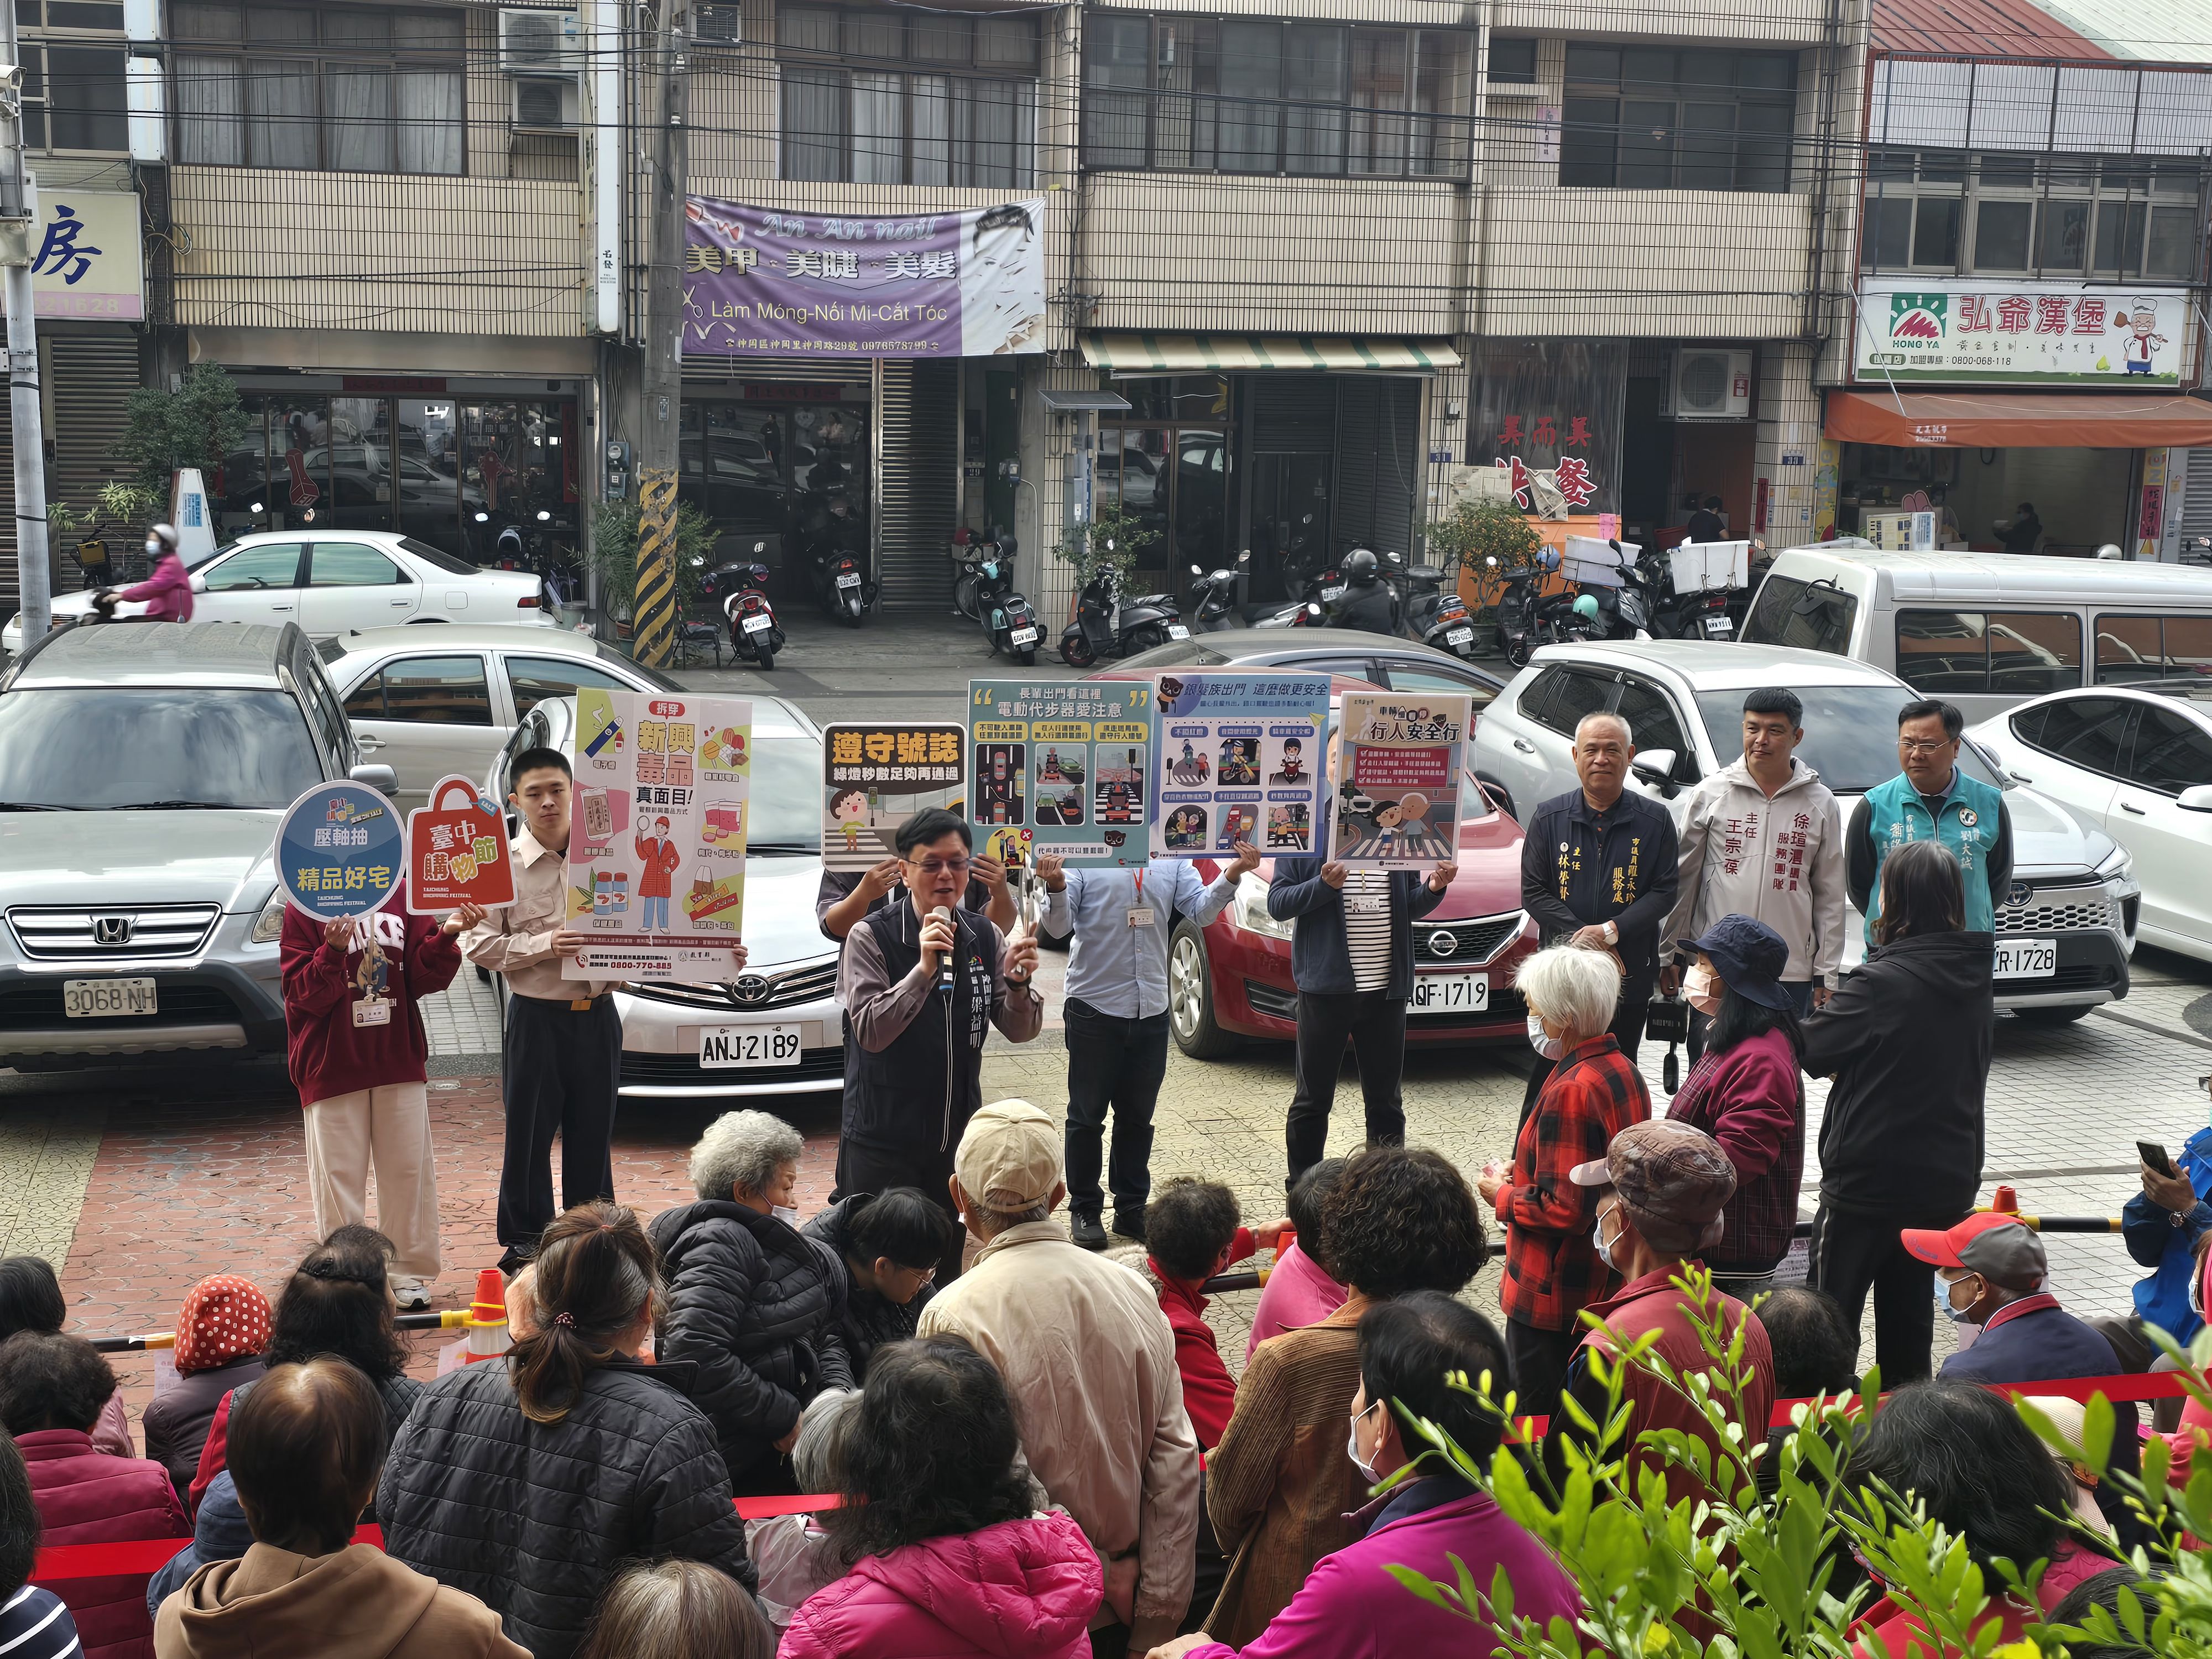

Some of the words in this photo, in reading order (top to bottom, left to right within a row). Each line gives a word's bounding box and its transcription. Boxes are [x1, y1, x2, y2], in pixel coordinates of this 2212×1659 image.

[755, 214, 807, 239] An
[814, 216, 867, 241] An
[873, 215, 937, 241] nail
[31, 205, 102, 285] 房
[686, 243, 759, 275] 美甲
[786, 248, 859, 279] 美睫
[885, 251, 957, 279] 美髮
[712, 300, 752, 318] Làm
[758, 298, 846, 325] Móng-Nối
[851, 301, 912, 323] Mi-Cắt
[916, 304, 947, 321] Tóc
[1957, 295, 2107, 336] 弘爺漢堡
[1892, 340, 1923, 349] HONG
[1926, 340, 1940, 349] YA
[1498, 415, 1592, 447] 美而美
[1183, 683, 1247, 696] 銀髮族出門
[656, 702, 679, 715] 拆穿
[998, 701, 1123, 718] 電動代步器愛注意
[637, 720, 696, 754] 新興
[1370, 721, 1461, 742] 行人安全行
[832, 732, 959, 764] 遵守號誌
[636, 753, 693, 786] 毒品
[833, 766, 959, 781] 綠燈秒數足夠再通過
[635, 786, 693, 806] 真面目!
[314, 827, 368, 847] 壓軸抽
[429, 820, 476, 851] 臺中
[1745, 812, 1758, 838] 主任
[424, 836, 498, 884] 購物節
[1571, 846, 1582, 871] 主任
[298, 865, 390, 891] 精品好宅
[66, 987, 156, 1011] 3068-NH
